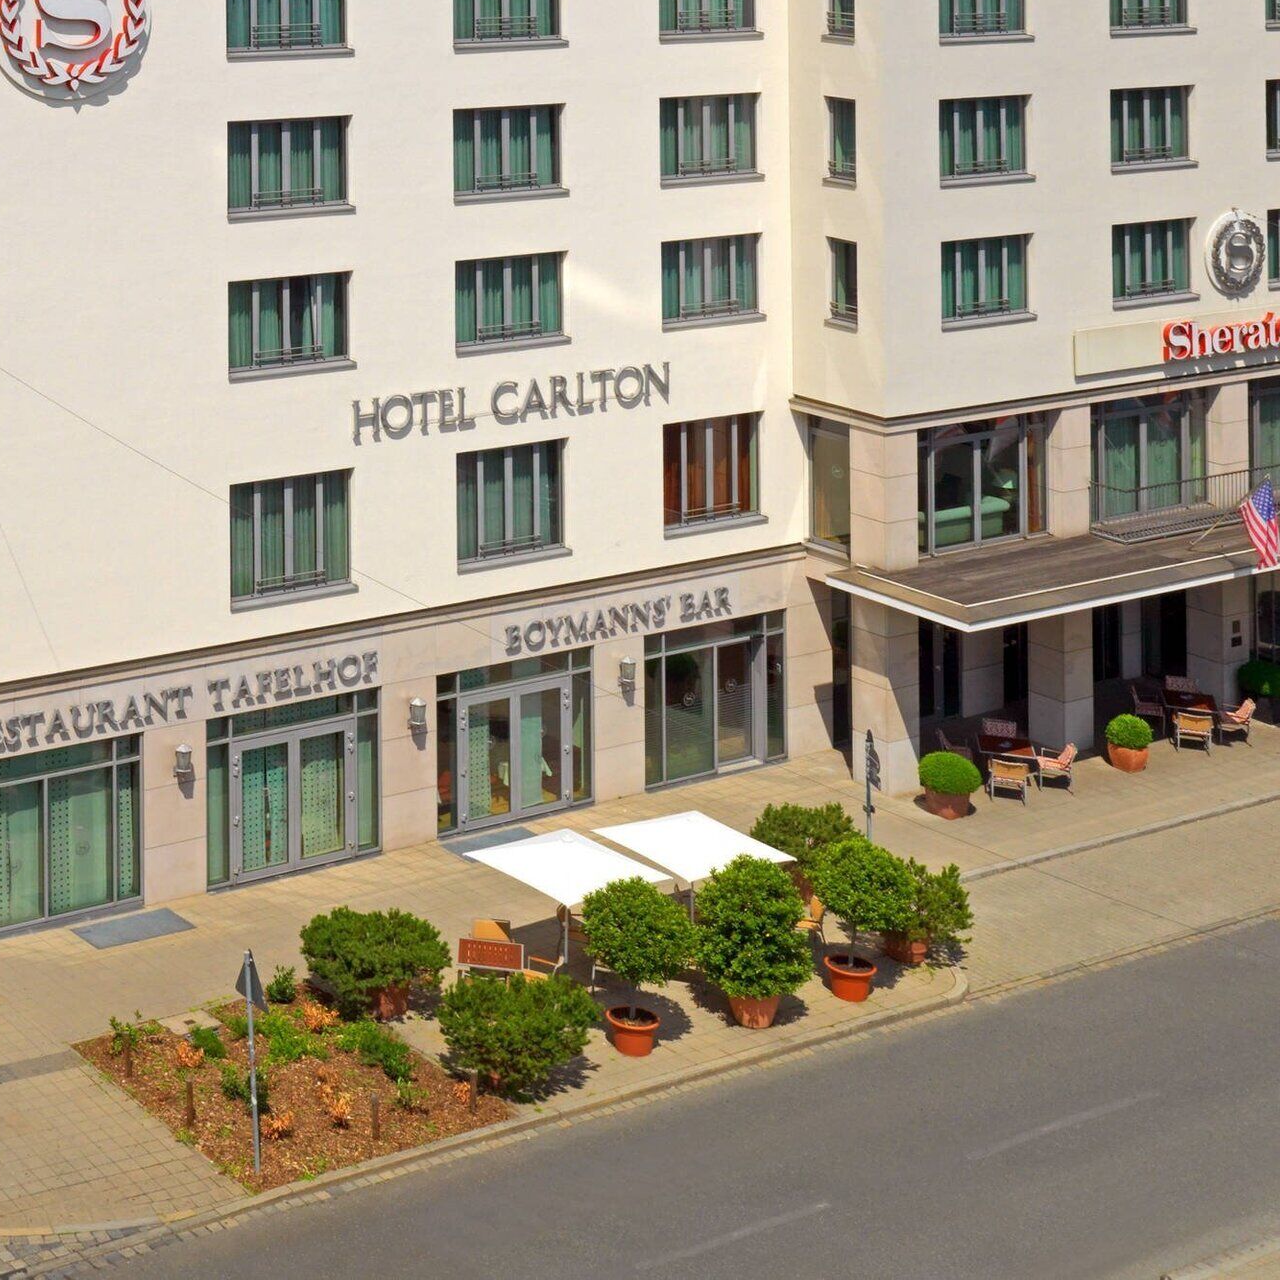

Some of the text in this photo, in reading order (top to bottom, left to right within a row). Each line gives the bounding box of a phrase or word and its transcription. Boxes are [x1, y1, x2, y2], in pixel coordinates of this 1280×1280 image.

[352, 362, 671, 443] HOTEL CARLTON
[505, 587, 732, 656] BOYMANNS' BAR
[207, 651, 378, 711] TAFELHOF
